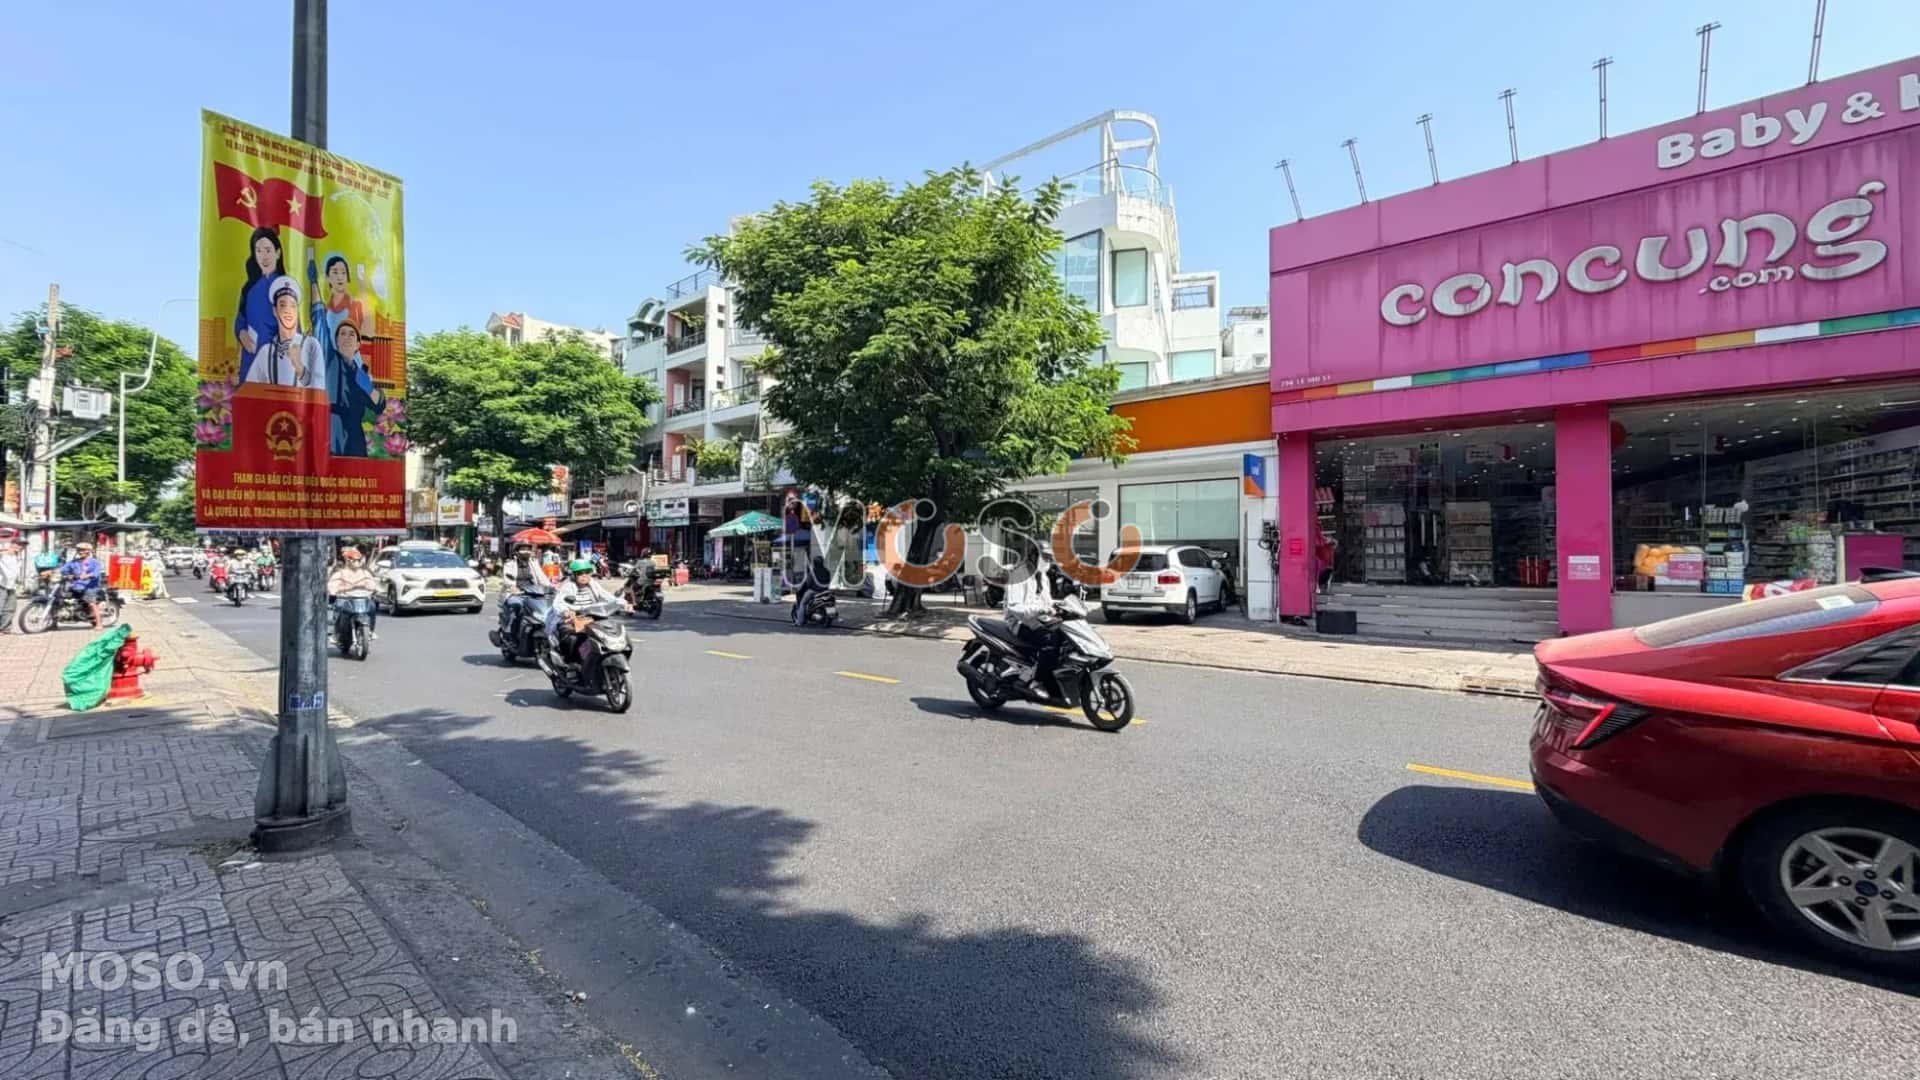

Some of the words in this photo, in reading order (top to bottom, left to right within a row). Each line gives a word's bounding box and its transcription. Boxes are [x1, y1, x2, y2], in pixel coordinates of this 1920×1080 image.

[1657, 102, 1828, 170] Baby
[1841, 92, 1886, 124] &
[1380, 180, 1887, 327] concung
[1699, 265, 1794, 296] .com
[233, 472, 253, 484] THAM
